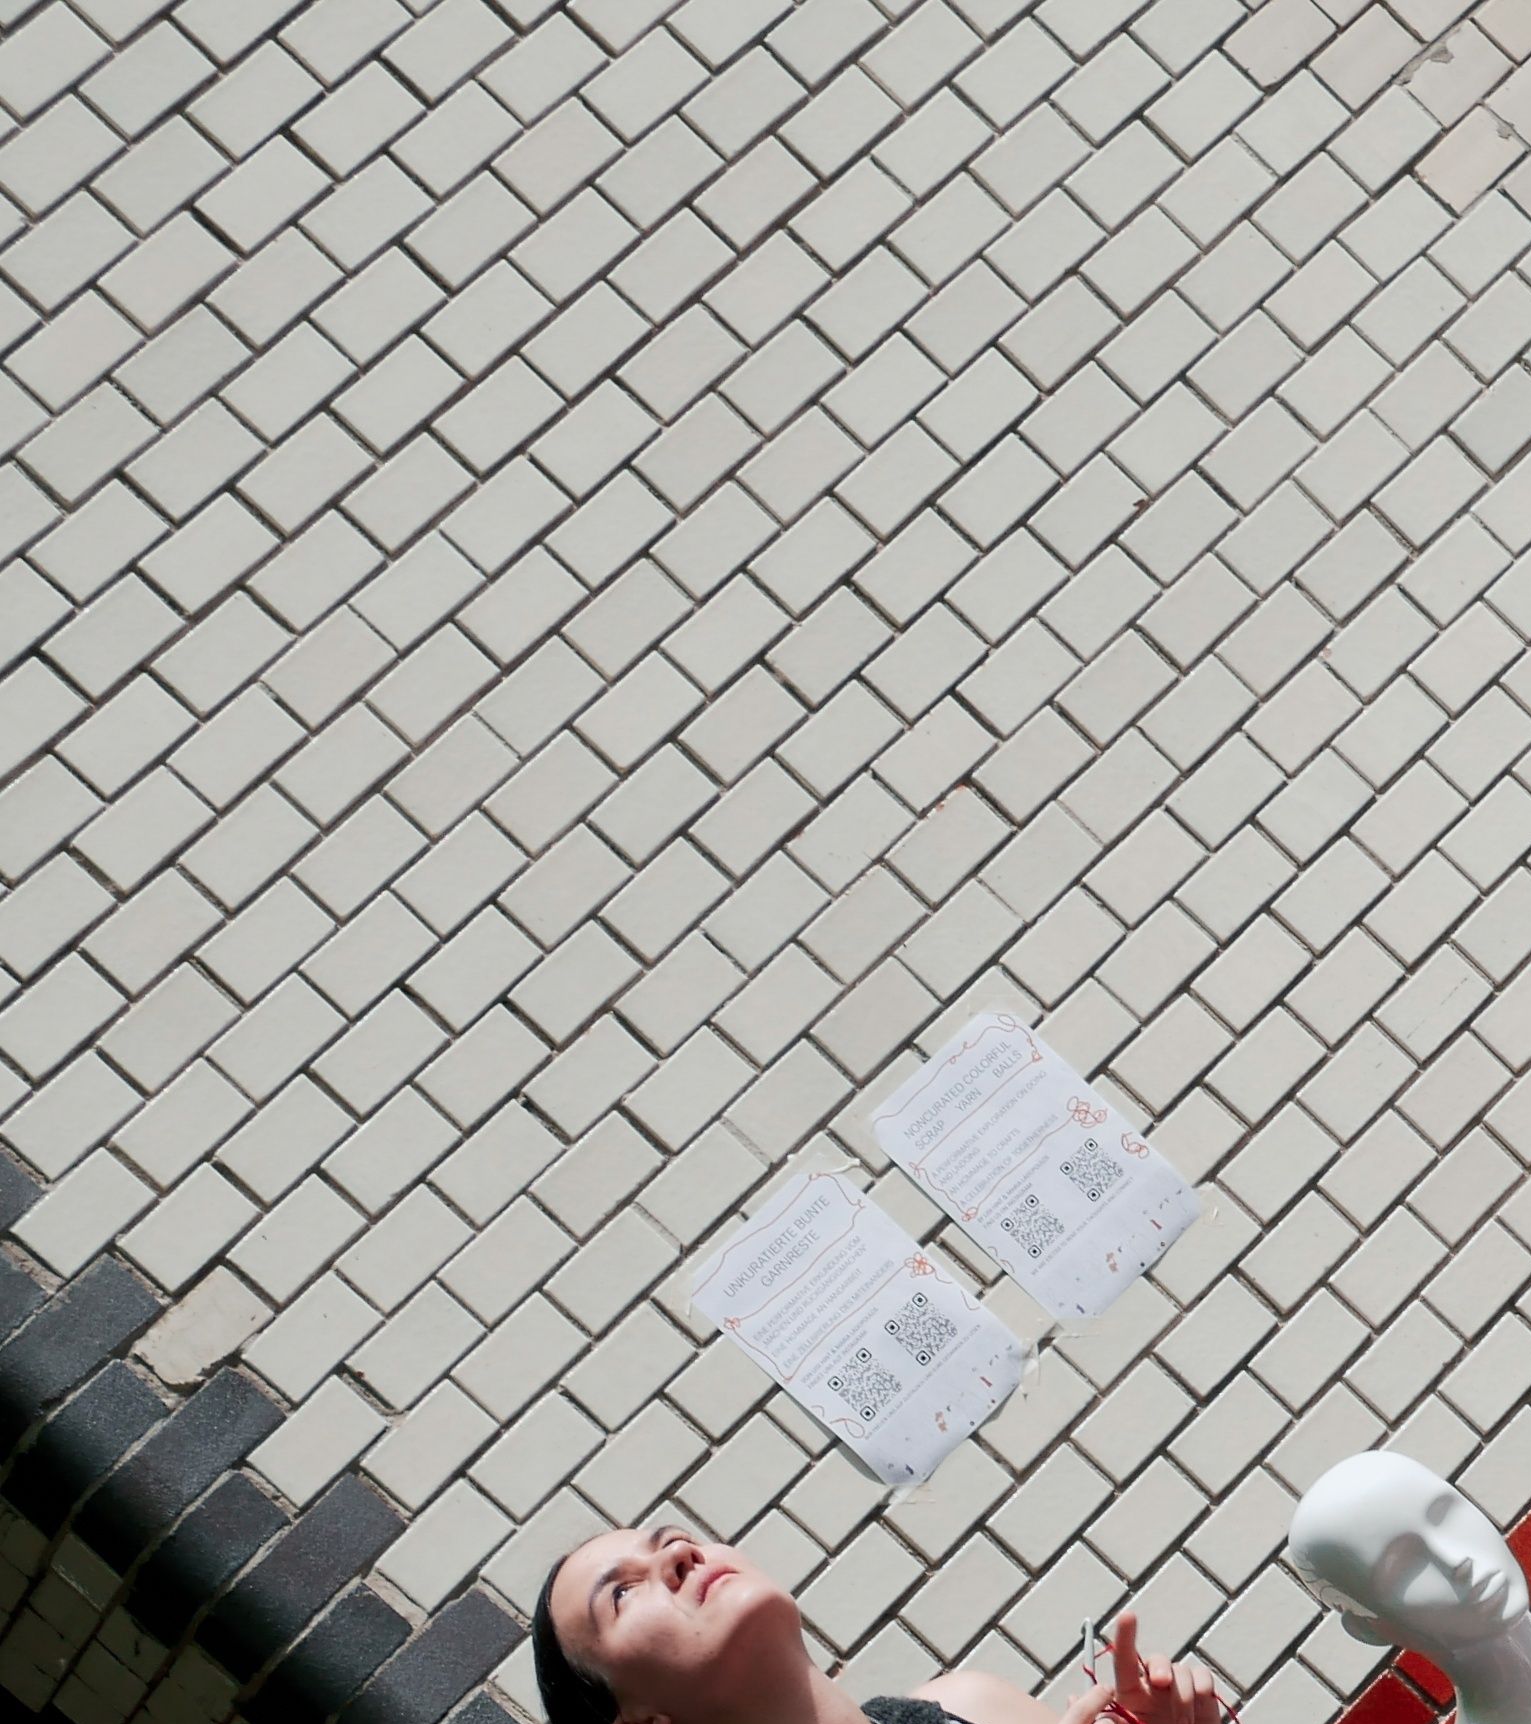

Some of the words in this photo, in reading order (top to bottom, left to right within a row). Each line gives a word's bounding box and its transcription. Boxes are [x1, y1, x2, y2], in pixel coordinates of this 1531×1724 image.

[904, 1082, 964, 1139] NONCURATED
[962, 1040, 1011, 1085] COLORFUL
[914, 1119, 946, 1149] SCRAP
[955, 1087, 981, 1112] YARN
[992, 1049, 1021, 1077] BALLS
[724, 1228, 796, 1298] UNKURATIERTE
[795, 1196, 829, 1230] BUNTE
[760, 1230, 819, 1287] GARNRESTE
